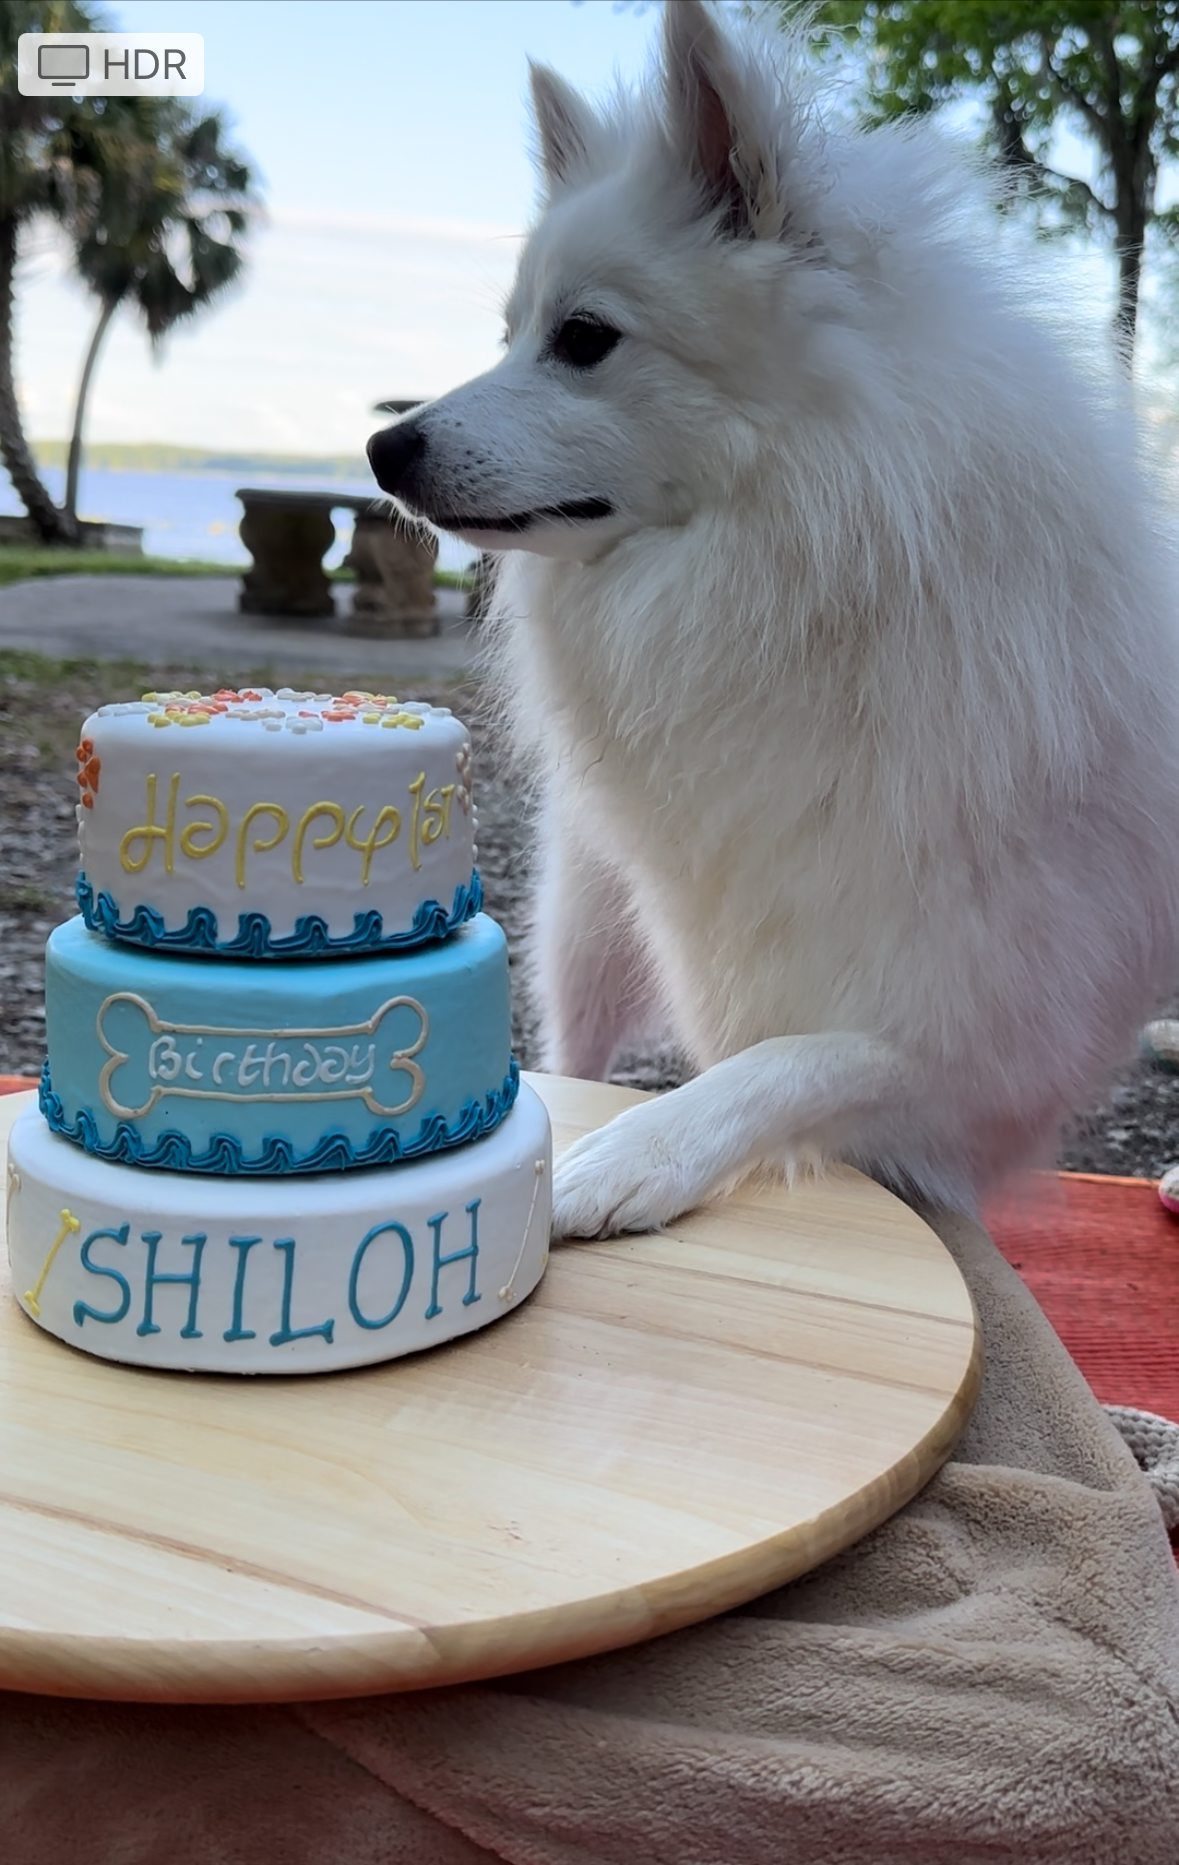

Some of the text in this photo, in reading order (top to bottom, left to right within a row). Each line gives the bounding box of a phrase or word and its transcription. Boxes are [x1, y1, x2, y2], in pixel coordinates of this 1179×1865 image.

[119, 772, 400, 889] Happy
[149, 1035, 376, 1087] Birthday
[72, 1197, 482, 1347] SHILOH
